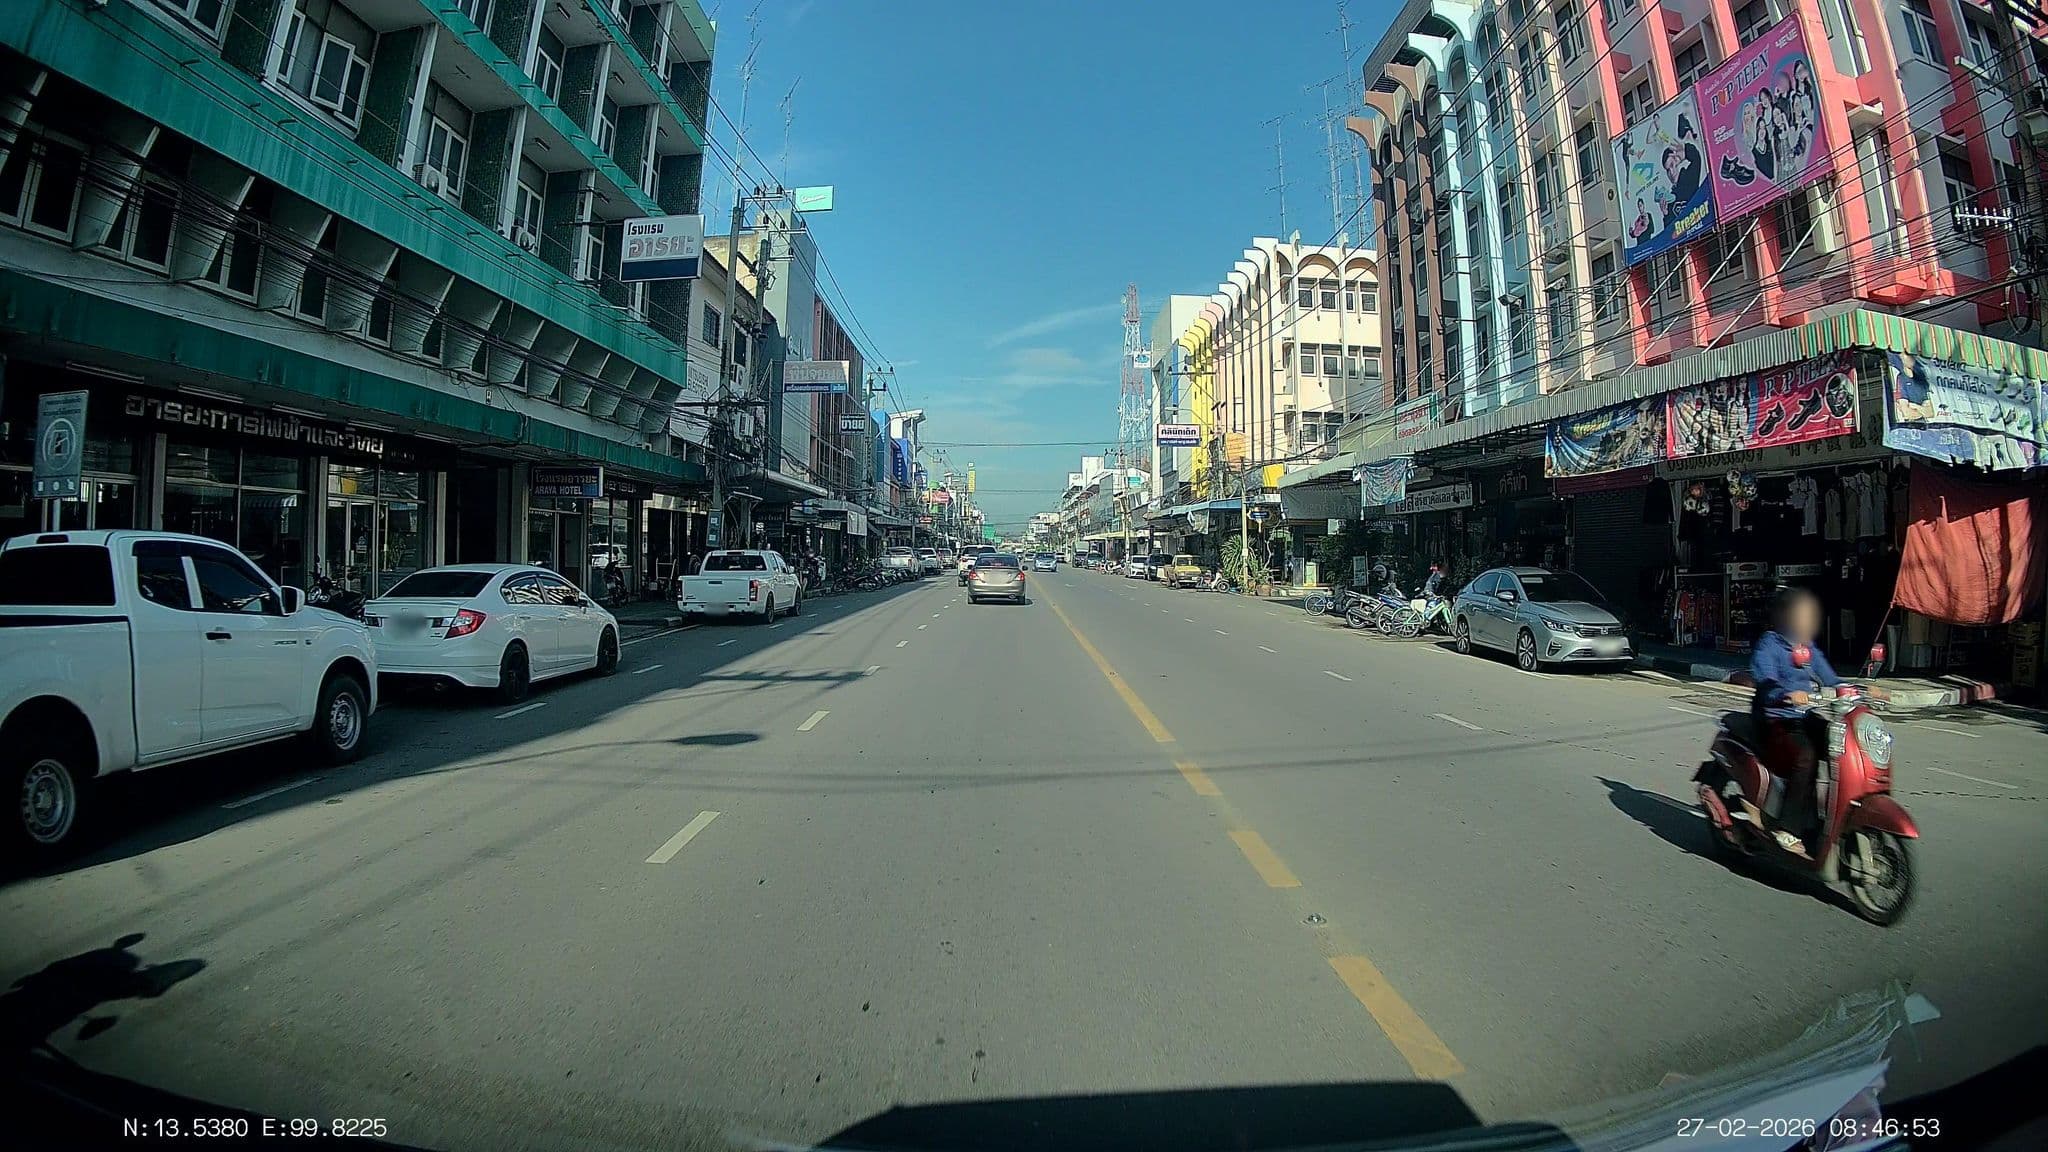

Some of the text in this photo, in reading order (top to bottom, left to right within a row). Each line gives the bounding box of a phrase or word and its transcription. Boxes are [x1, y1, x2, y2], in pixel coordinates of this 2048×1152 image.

[1674, 200, 1709, 237] Breaker
[628, 222, 664, 236] โรงแรม
[629, 235, 695, 258] อารยะ
[125, 394, 384, 460] อารยะการไฟฟ้าและวิทยุ
[1161, 427, 1197, 436] คลินิกเด็ก
[535, 484, 583, 495] ARAYA HOTEL
